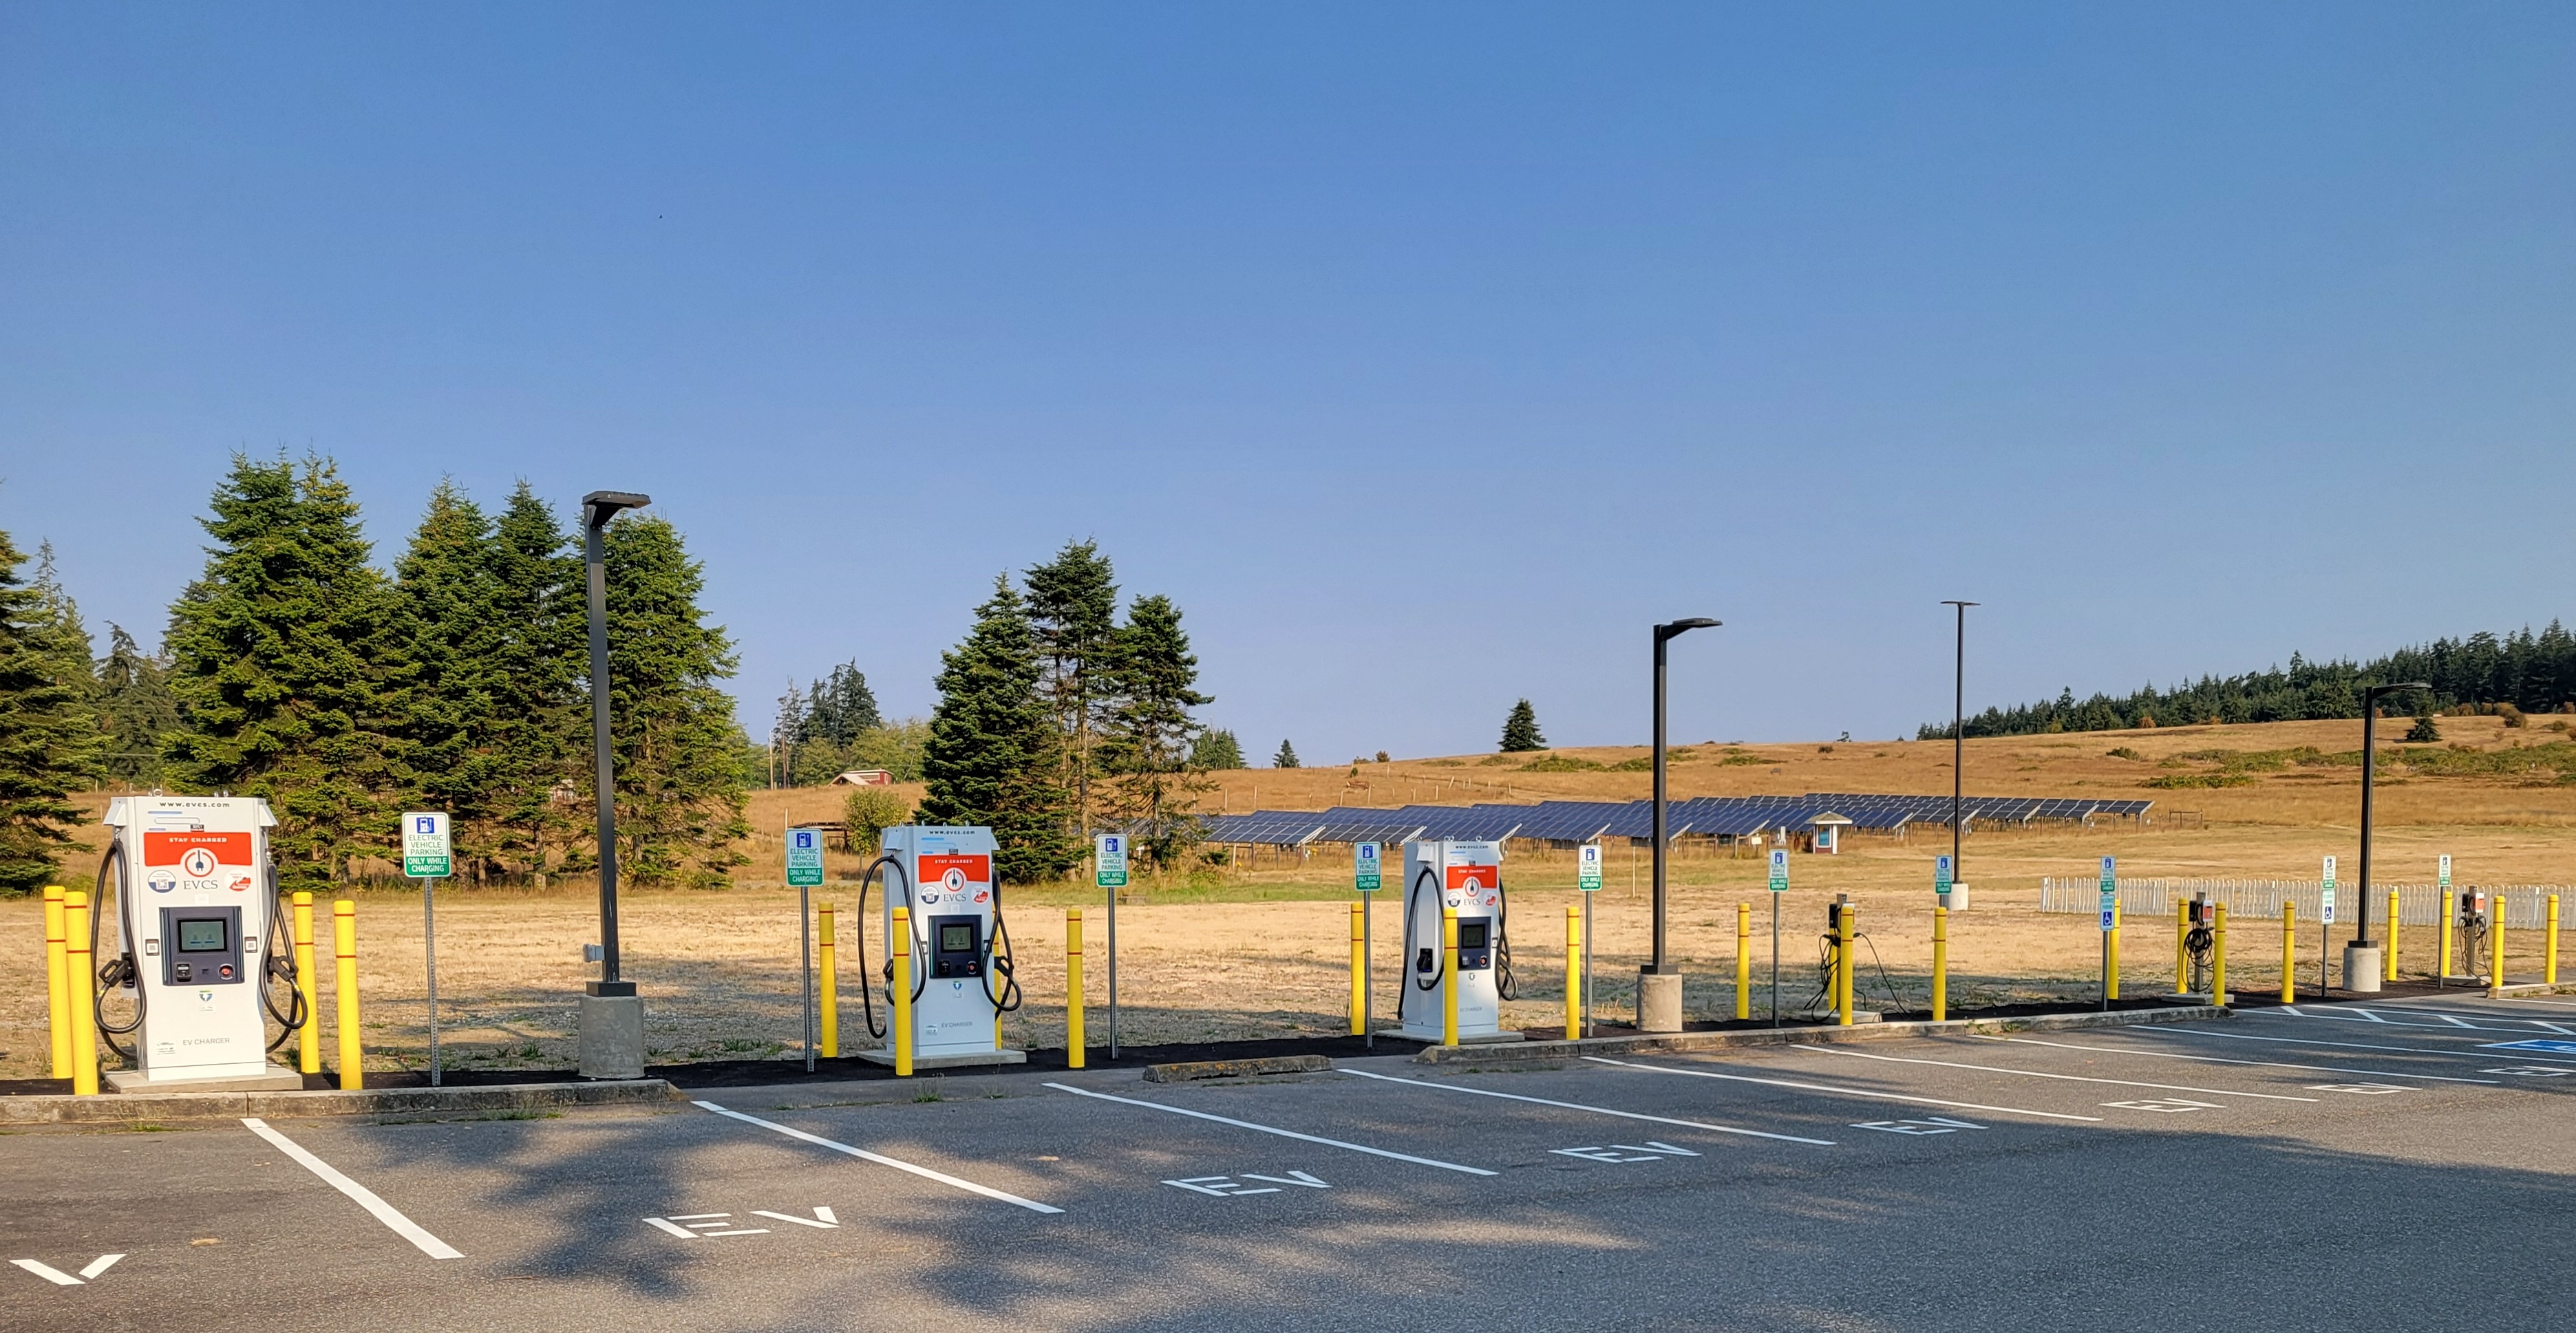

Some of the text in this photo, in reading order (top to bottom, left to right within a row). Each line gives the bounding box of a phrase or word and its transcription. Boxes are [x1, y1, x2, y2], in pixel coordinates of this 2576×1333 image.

[407, 857, 425, 865] ONLY
[183, 879, 218, 890] EVCS
[943, 893, 967, 902] EVCS
[2098, 1098, 2227, 1112] EV
[1848, 1117, 1989, 1135] EV
[1547, 1141, 1703, 1163] EV
[1160, 1171, 1334, 1196] EV
[642, 1206, 840, 1239] EV
